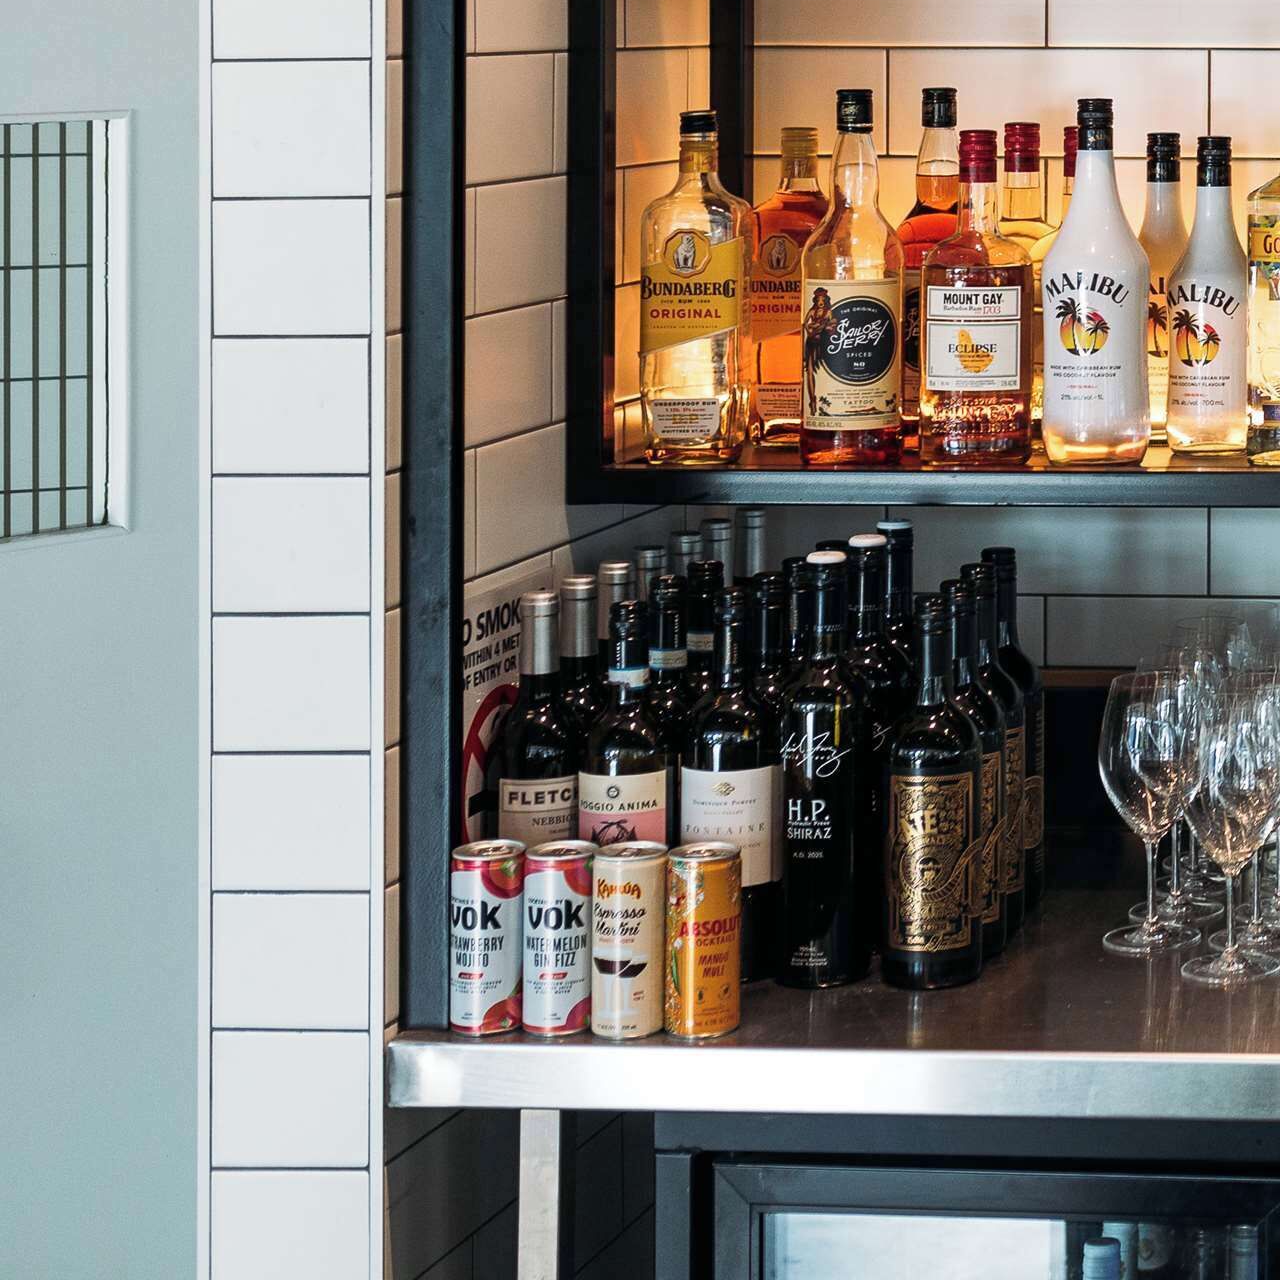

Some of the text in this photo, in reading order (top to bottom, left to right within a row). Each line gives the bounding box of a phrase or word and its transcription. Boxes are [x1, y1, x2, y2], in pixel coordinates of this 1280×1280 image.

[641, 276, 737, 300] BUNDABERG
[1045, 271, 1130, 305] MALIBU
[943, 292, 1003, 306] MOUNT GAY
[650, 307, 722, 320] ORIGINAL
[948, 343, 998, 354] ECLIPSE
[494, 643, 500, 656] 4
[474, 658, 517, 688] ENTRY OR
[619, 799, 659, 811] ANIMA
[787, 799, 831, 821] H.P.
[684, 822, 768, 836] FONTAINE
[787, 826, 832, 840] SHIRAZ
[525, 934, 587, 952] WATERMELON
[455, 952, 490, 968] MOJITO
[534, 951, 576, 968] GIN FIZZ
